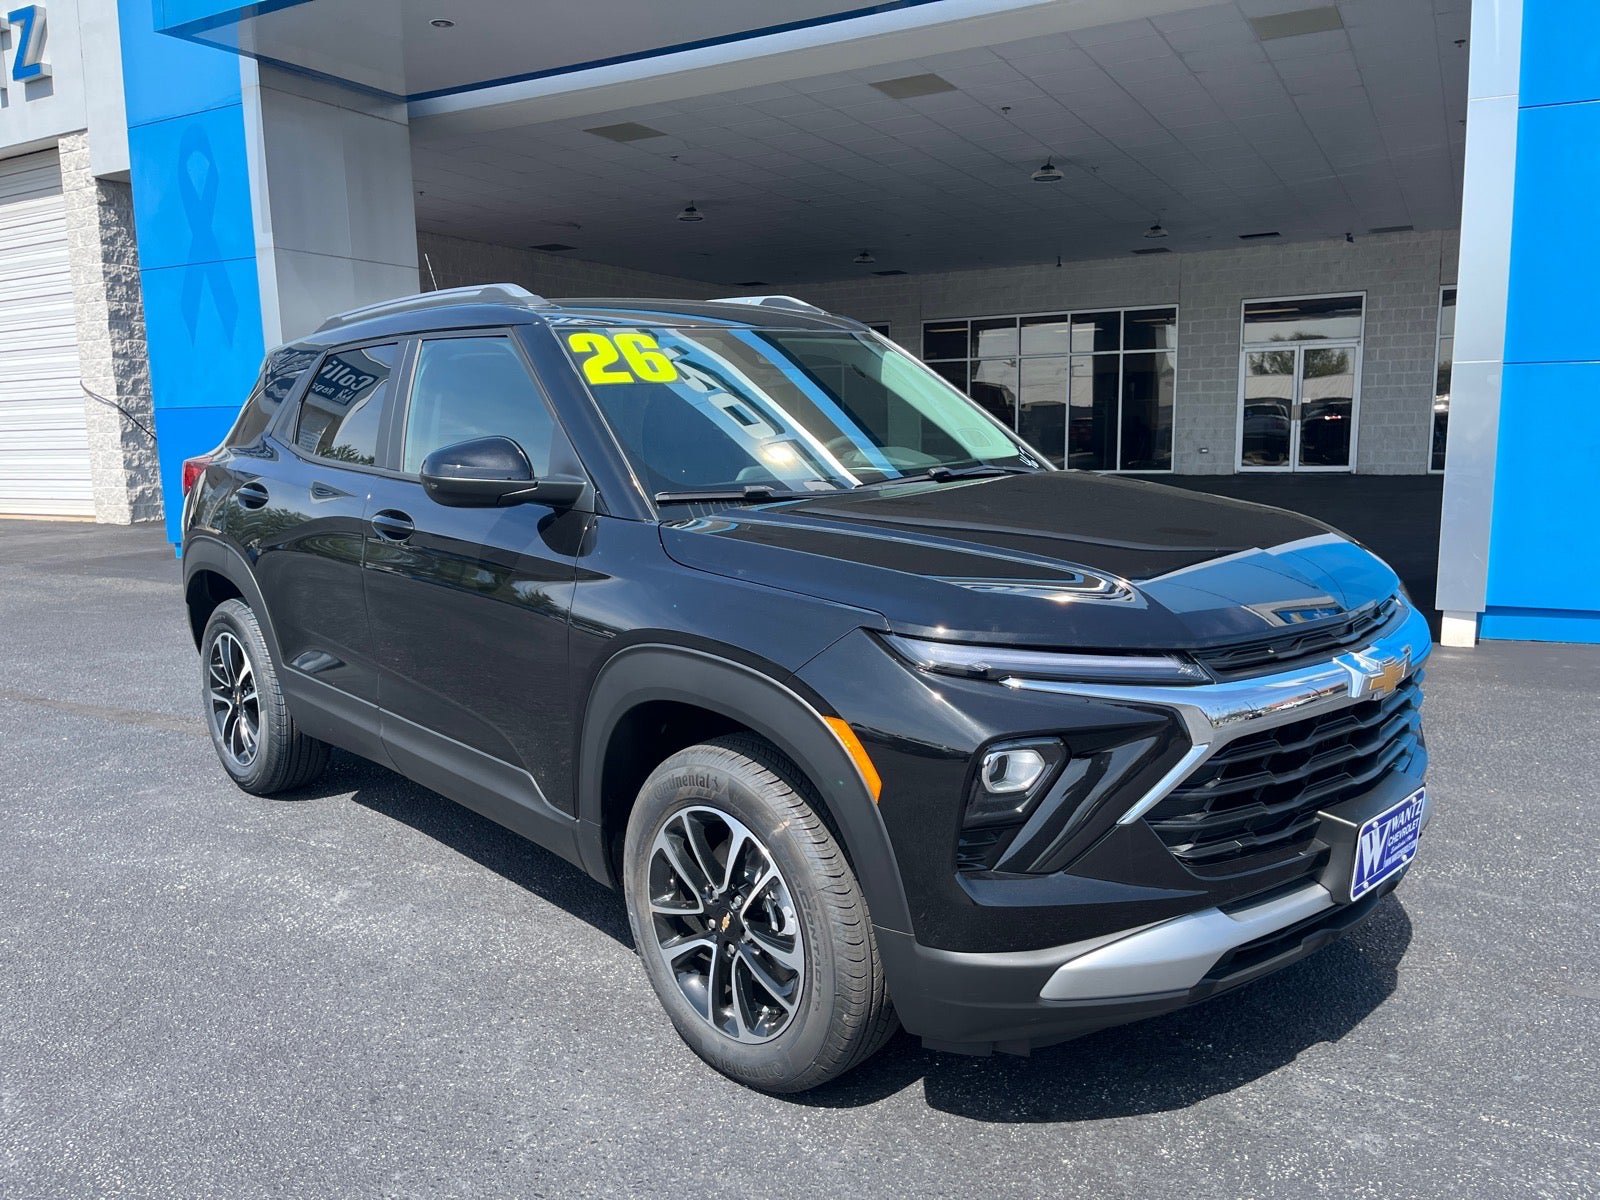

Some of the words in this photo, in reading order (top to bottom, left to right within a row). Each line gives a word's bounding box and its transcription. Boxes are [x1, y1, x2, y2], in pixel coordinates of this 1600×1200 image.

[568, 333, 678, 385] 26
[1388, 817, 1420, 847] CHEVROLET
[1391, 798, 1423, 832] WANTZ
[1360, 820, 1391, 879] W
